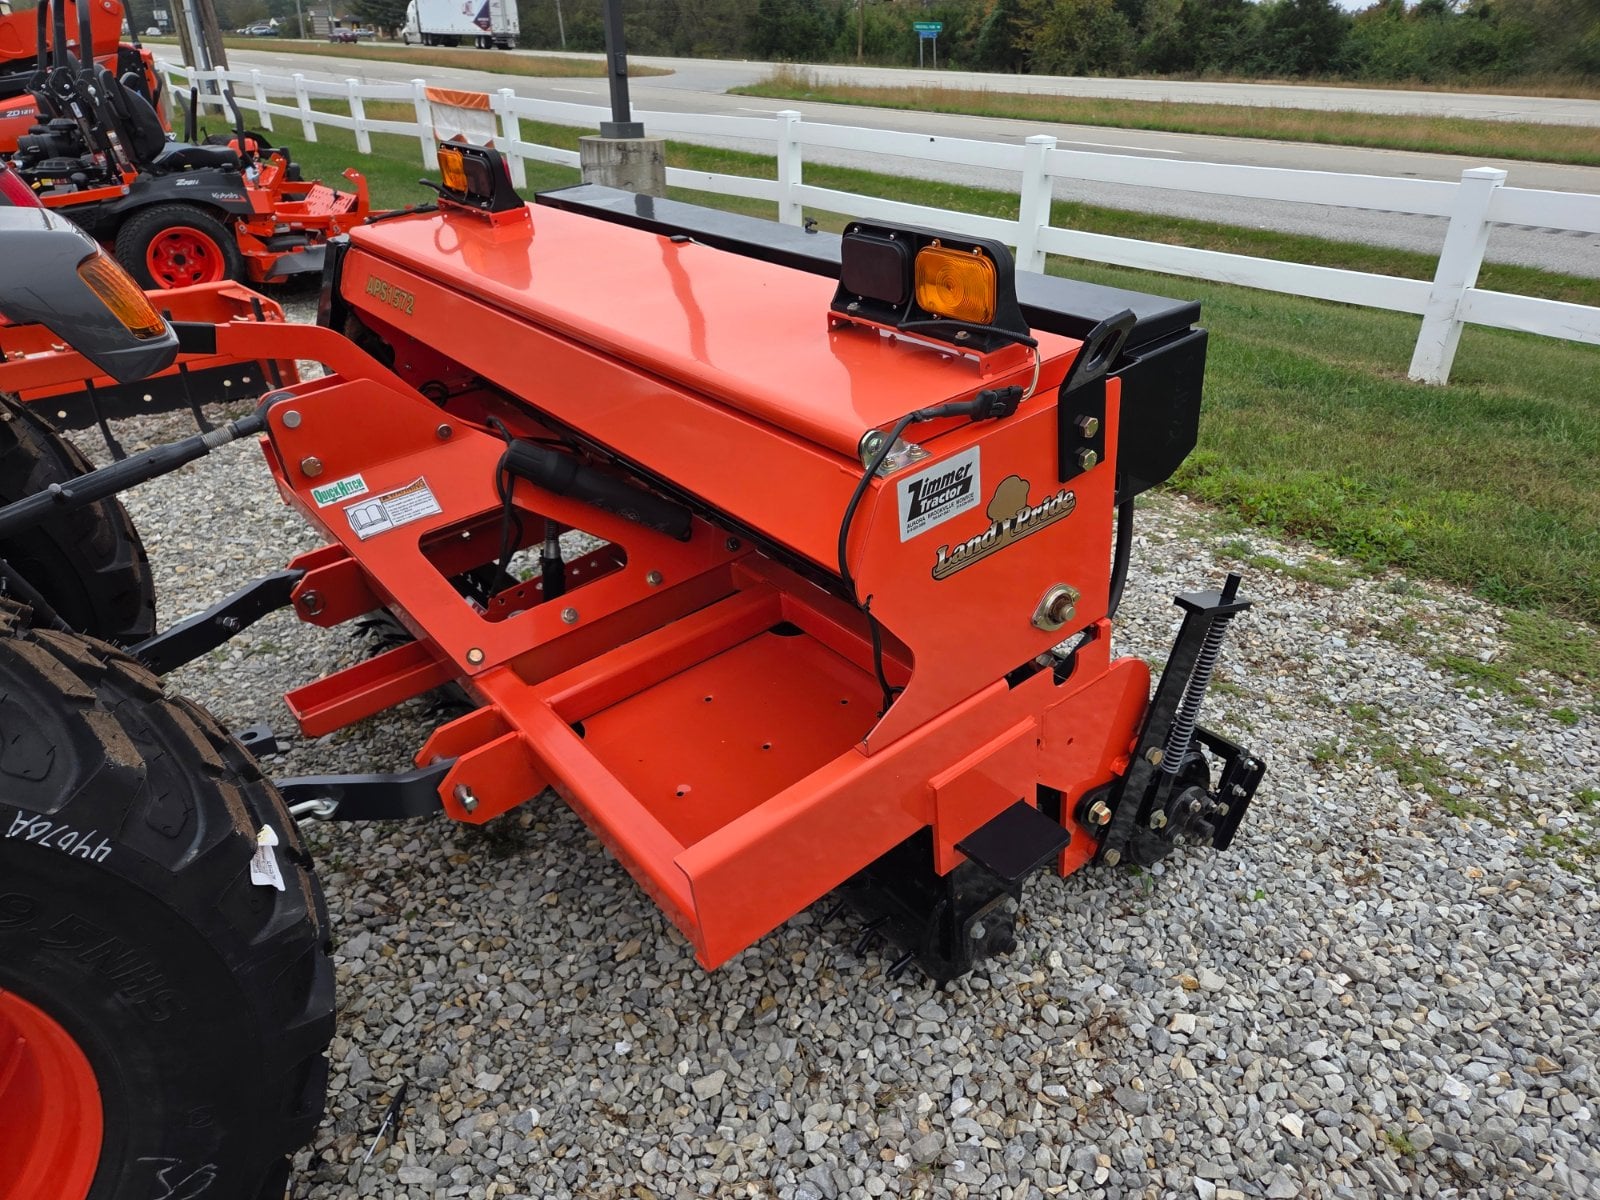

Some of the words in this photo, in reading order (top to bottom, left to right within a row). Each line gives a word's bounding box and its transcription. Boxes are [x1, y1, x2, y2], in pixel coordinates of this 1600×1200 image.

[366, 275, 415, 315] APS1572
[907, 462, 973, 515] Zimmer
[920, 484, 963, 513] Tractor
[934, 521, 998, 571] Land
[1014, 489, 1075, 533] Pride
